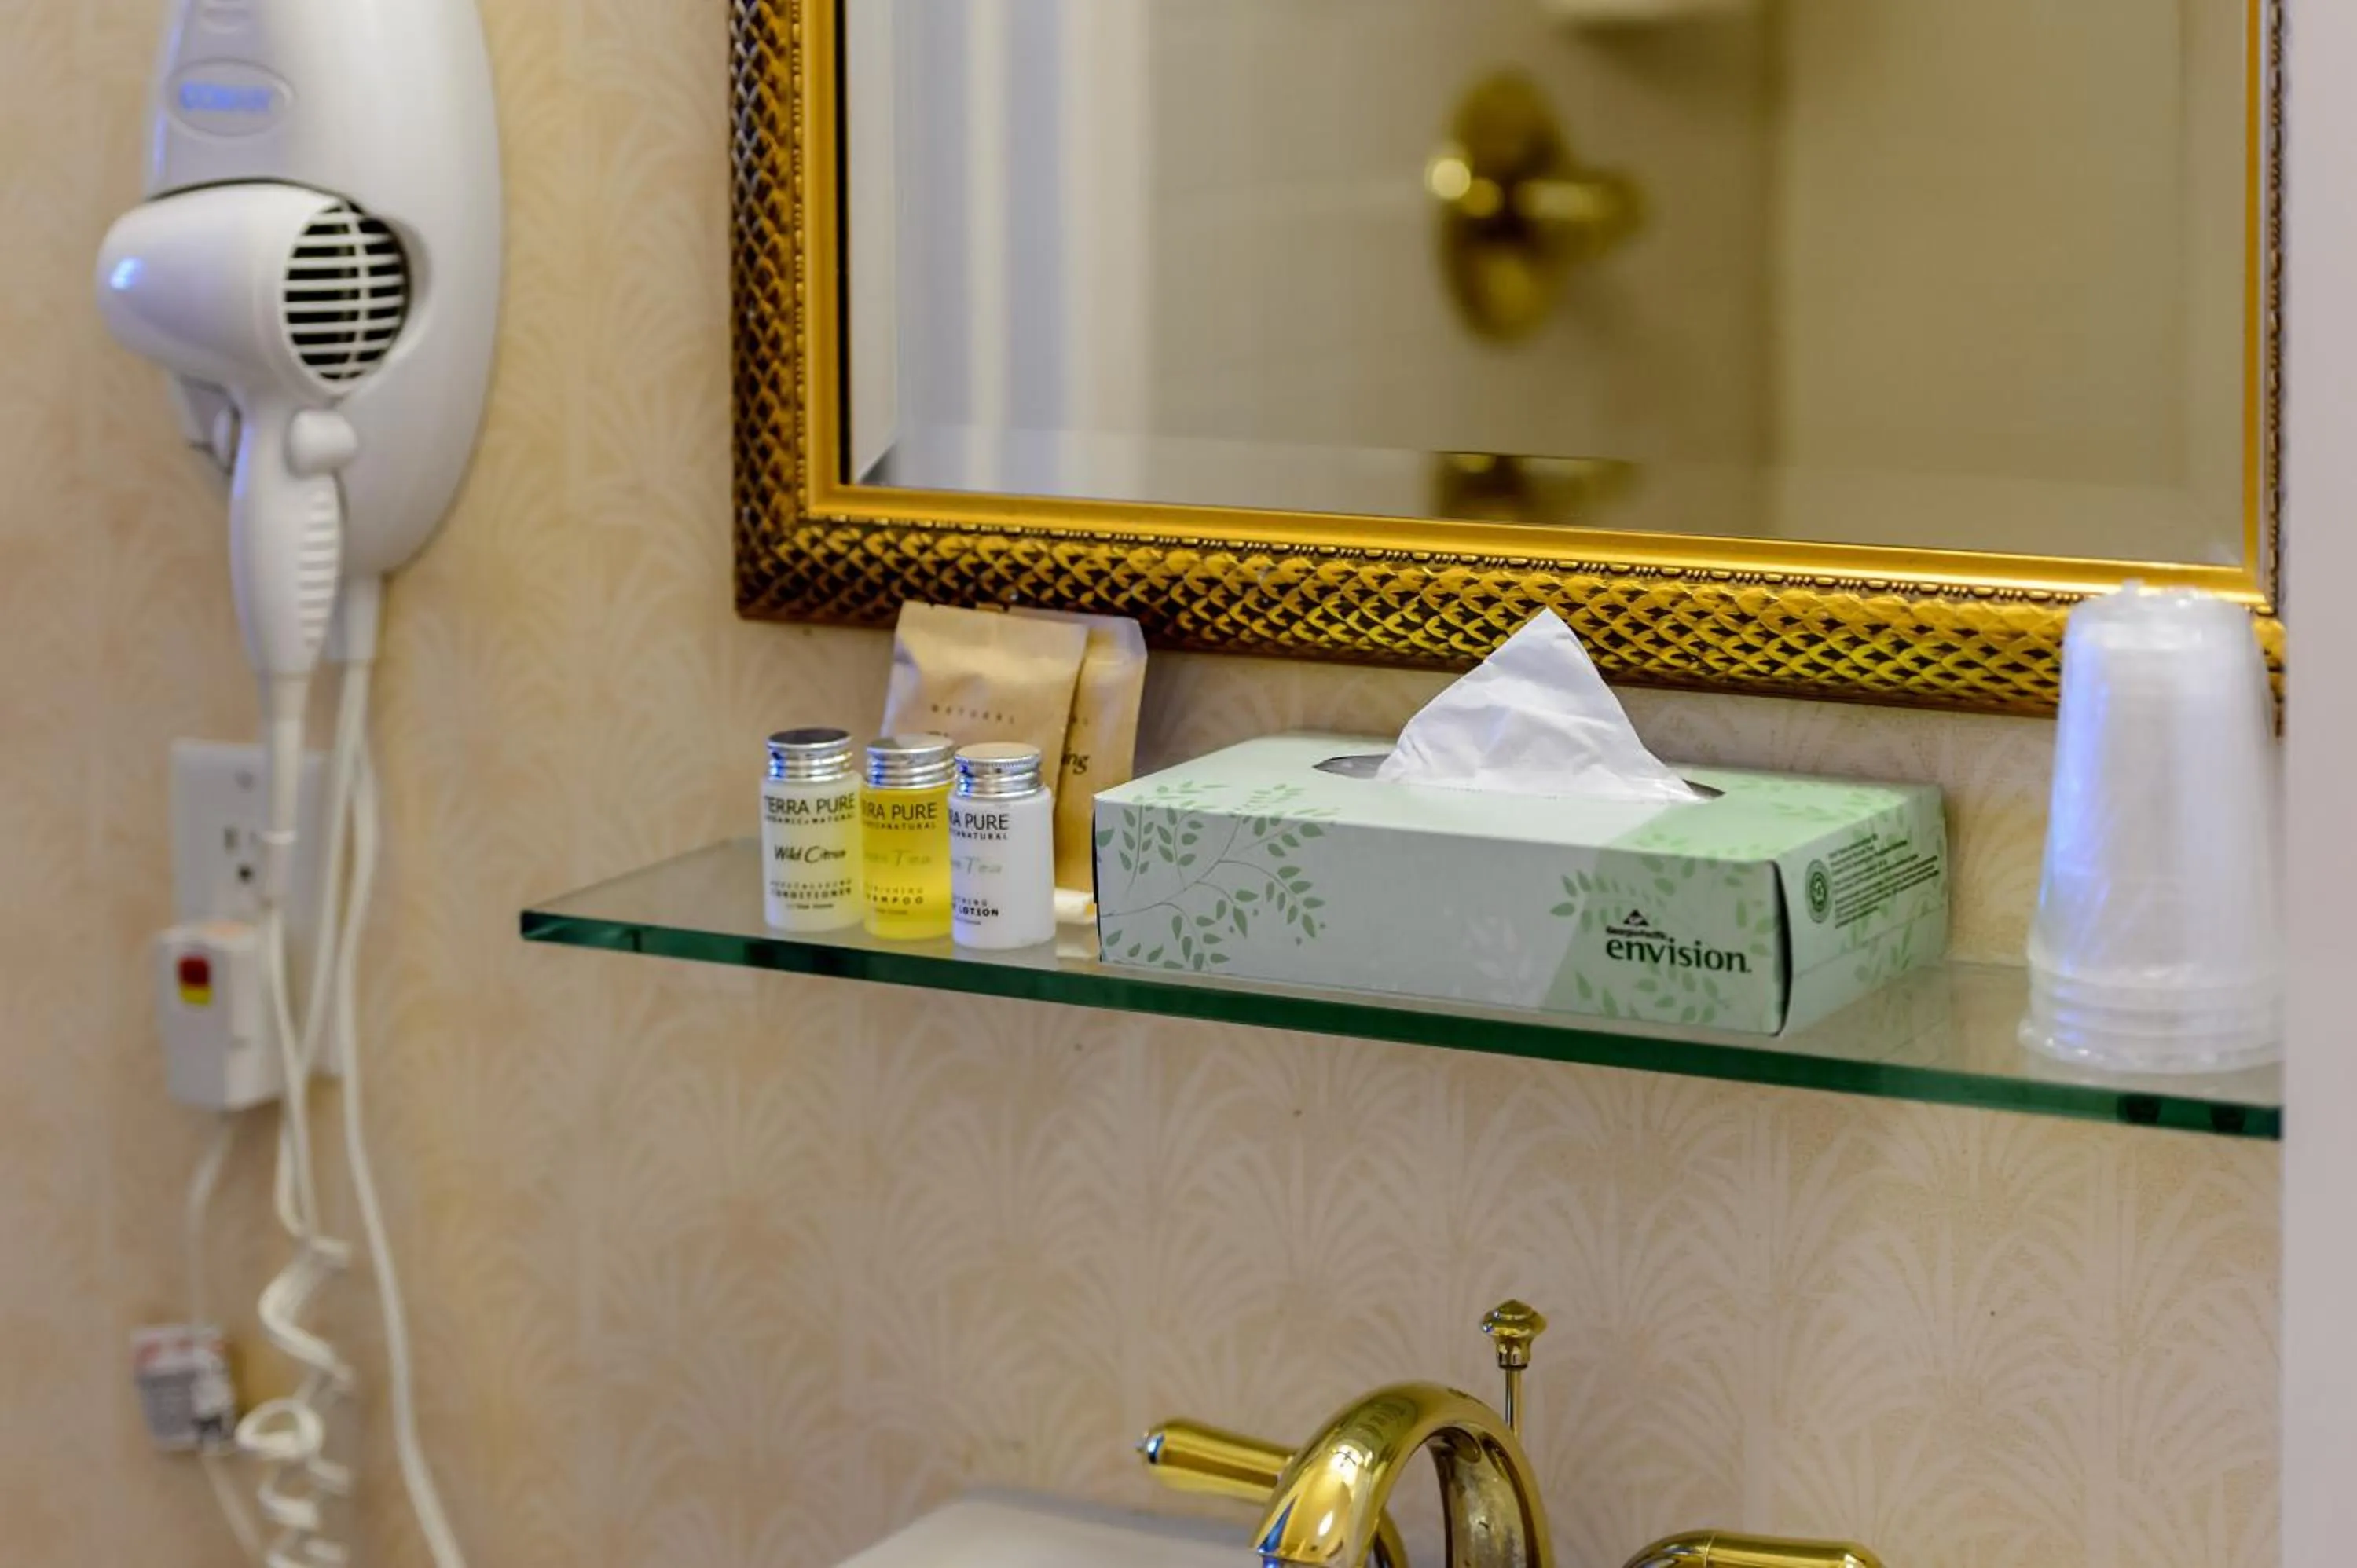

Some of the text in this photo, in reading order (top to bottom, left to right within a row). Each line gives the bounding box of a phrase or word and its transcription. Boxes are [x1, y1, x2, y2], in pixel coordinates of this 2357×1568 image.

[764, 793, 855, 815] TERRA PURE
[891, 802, 938, 821] PURE
[964, 813, 1010, 830] PURE
[774, 844, 803, 861] Wild
